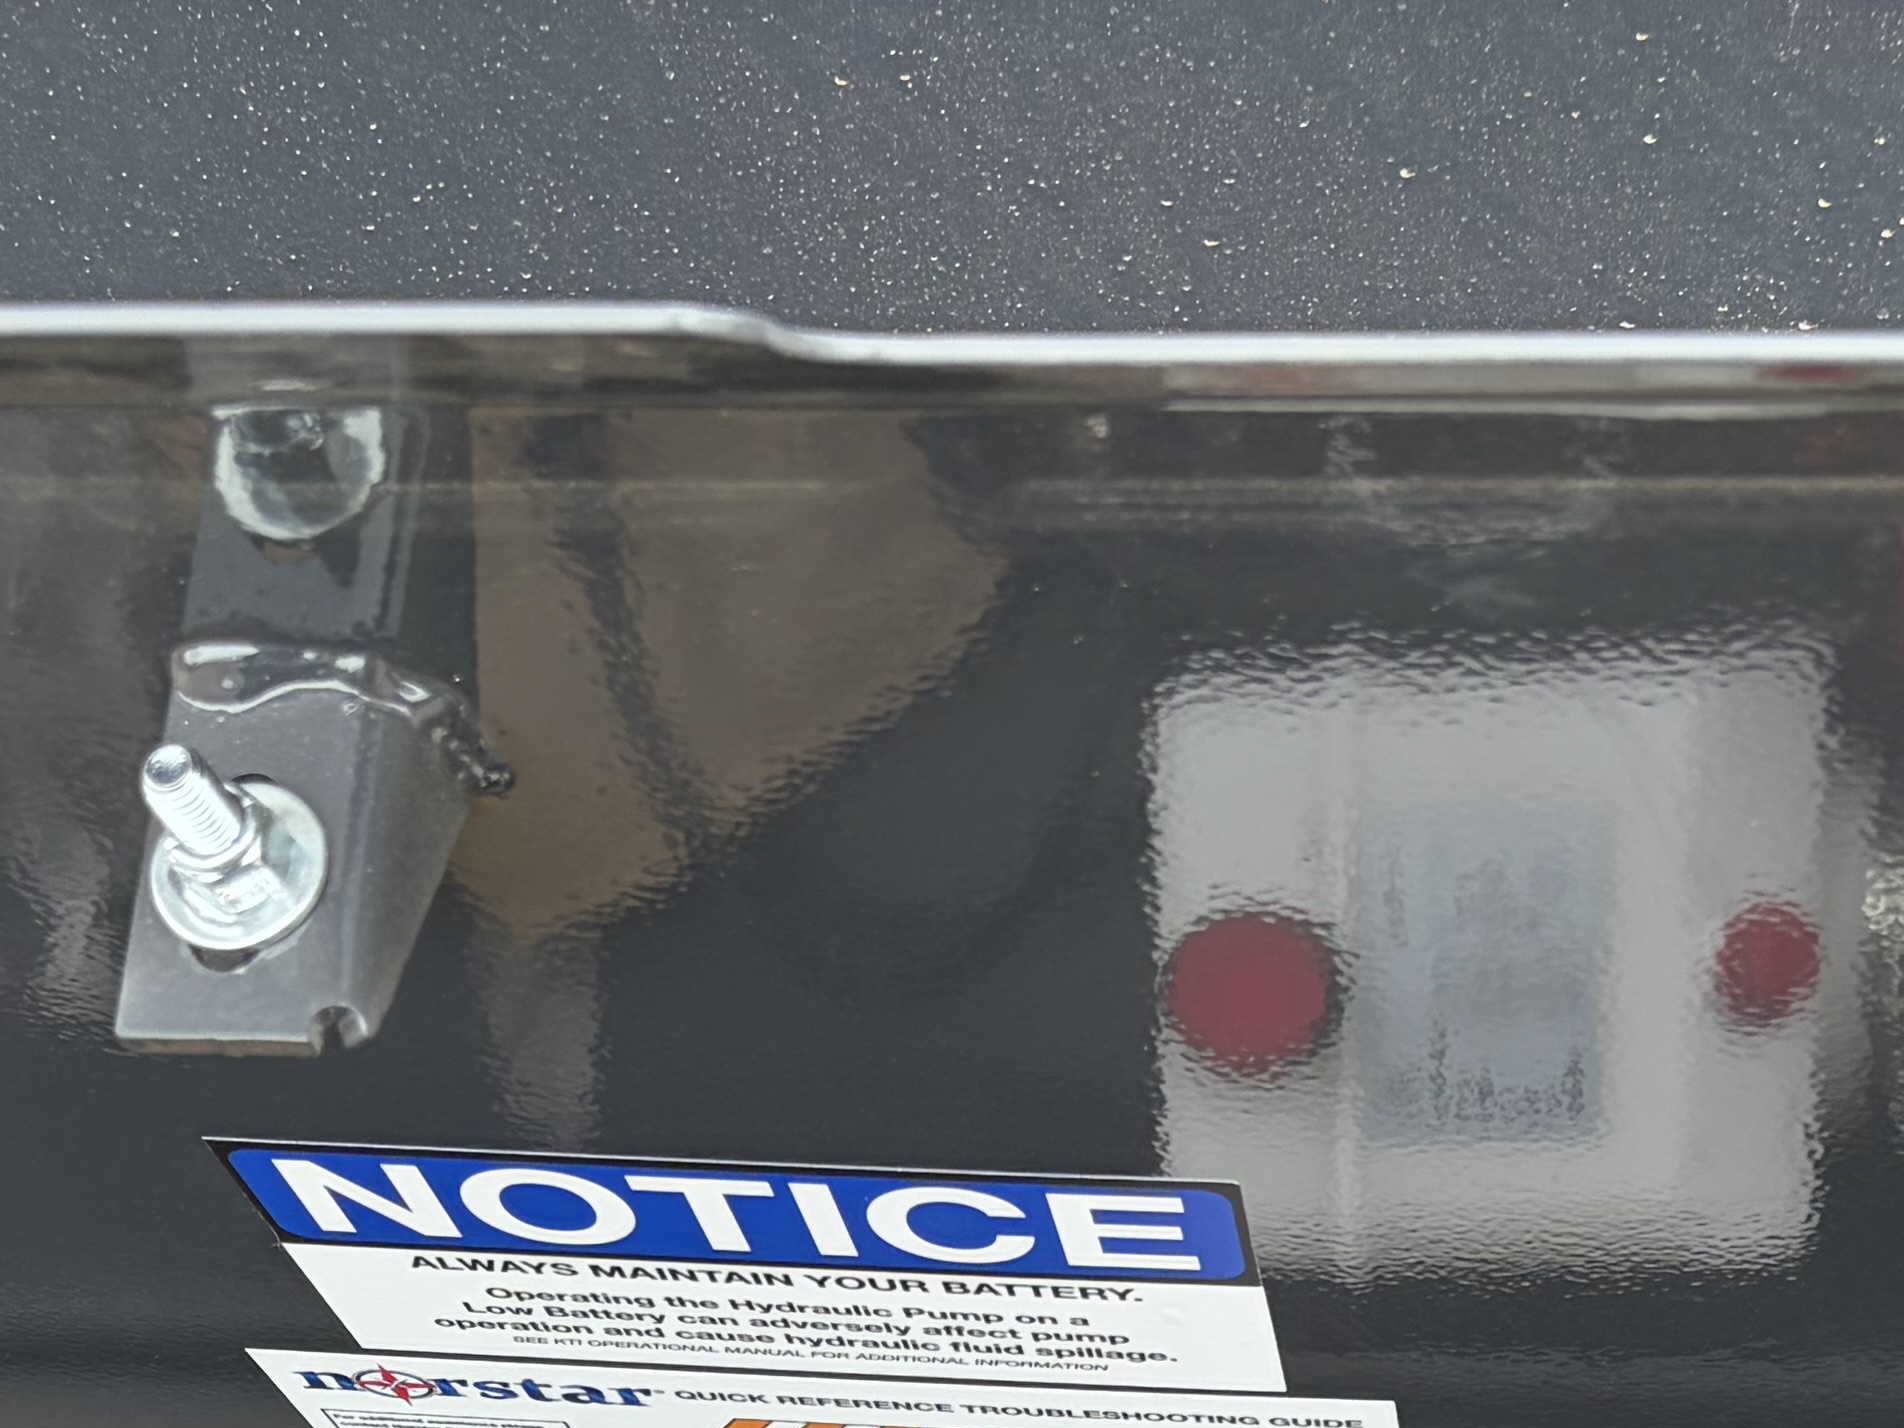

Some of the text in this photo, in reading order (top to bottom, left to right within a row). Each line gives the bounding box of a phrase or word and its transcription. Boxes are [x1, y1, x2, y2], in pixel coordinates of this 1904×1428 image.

[269, 1157, 1204, 1271] NOTICE
[411, 1255, 1143, 1302] ALWAYS MAINTAIN YOUR BATTERY.
[461, 1301, 1130, 1346] Low Battery can adversely affect pump
[485, 1287, 1089, 1327] Operating the Hydraulic Pump on a
[434, 1318, 1178, 1364] operation and cause hydraulic fluid spillage.
[587, 1339, 719, 1354] OPERATIONAL
[724, 1346, 806, 1358] MANUAL
[855, 1352, 970, 1366] ADDITIONAL
[974, 1358, 1109, 1372] INFORMATION
[673, 1390, 770, 1404] QUICK
[775, 1395, 954, 1413] REFERENCE
[960, 1404, 1259, 1425] TROUBLESHOOTING
